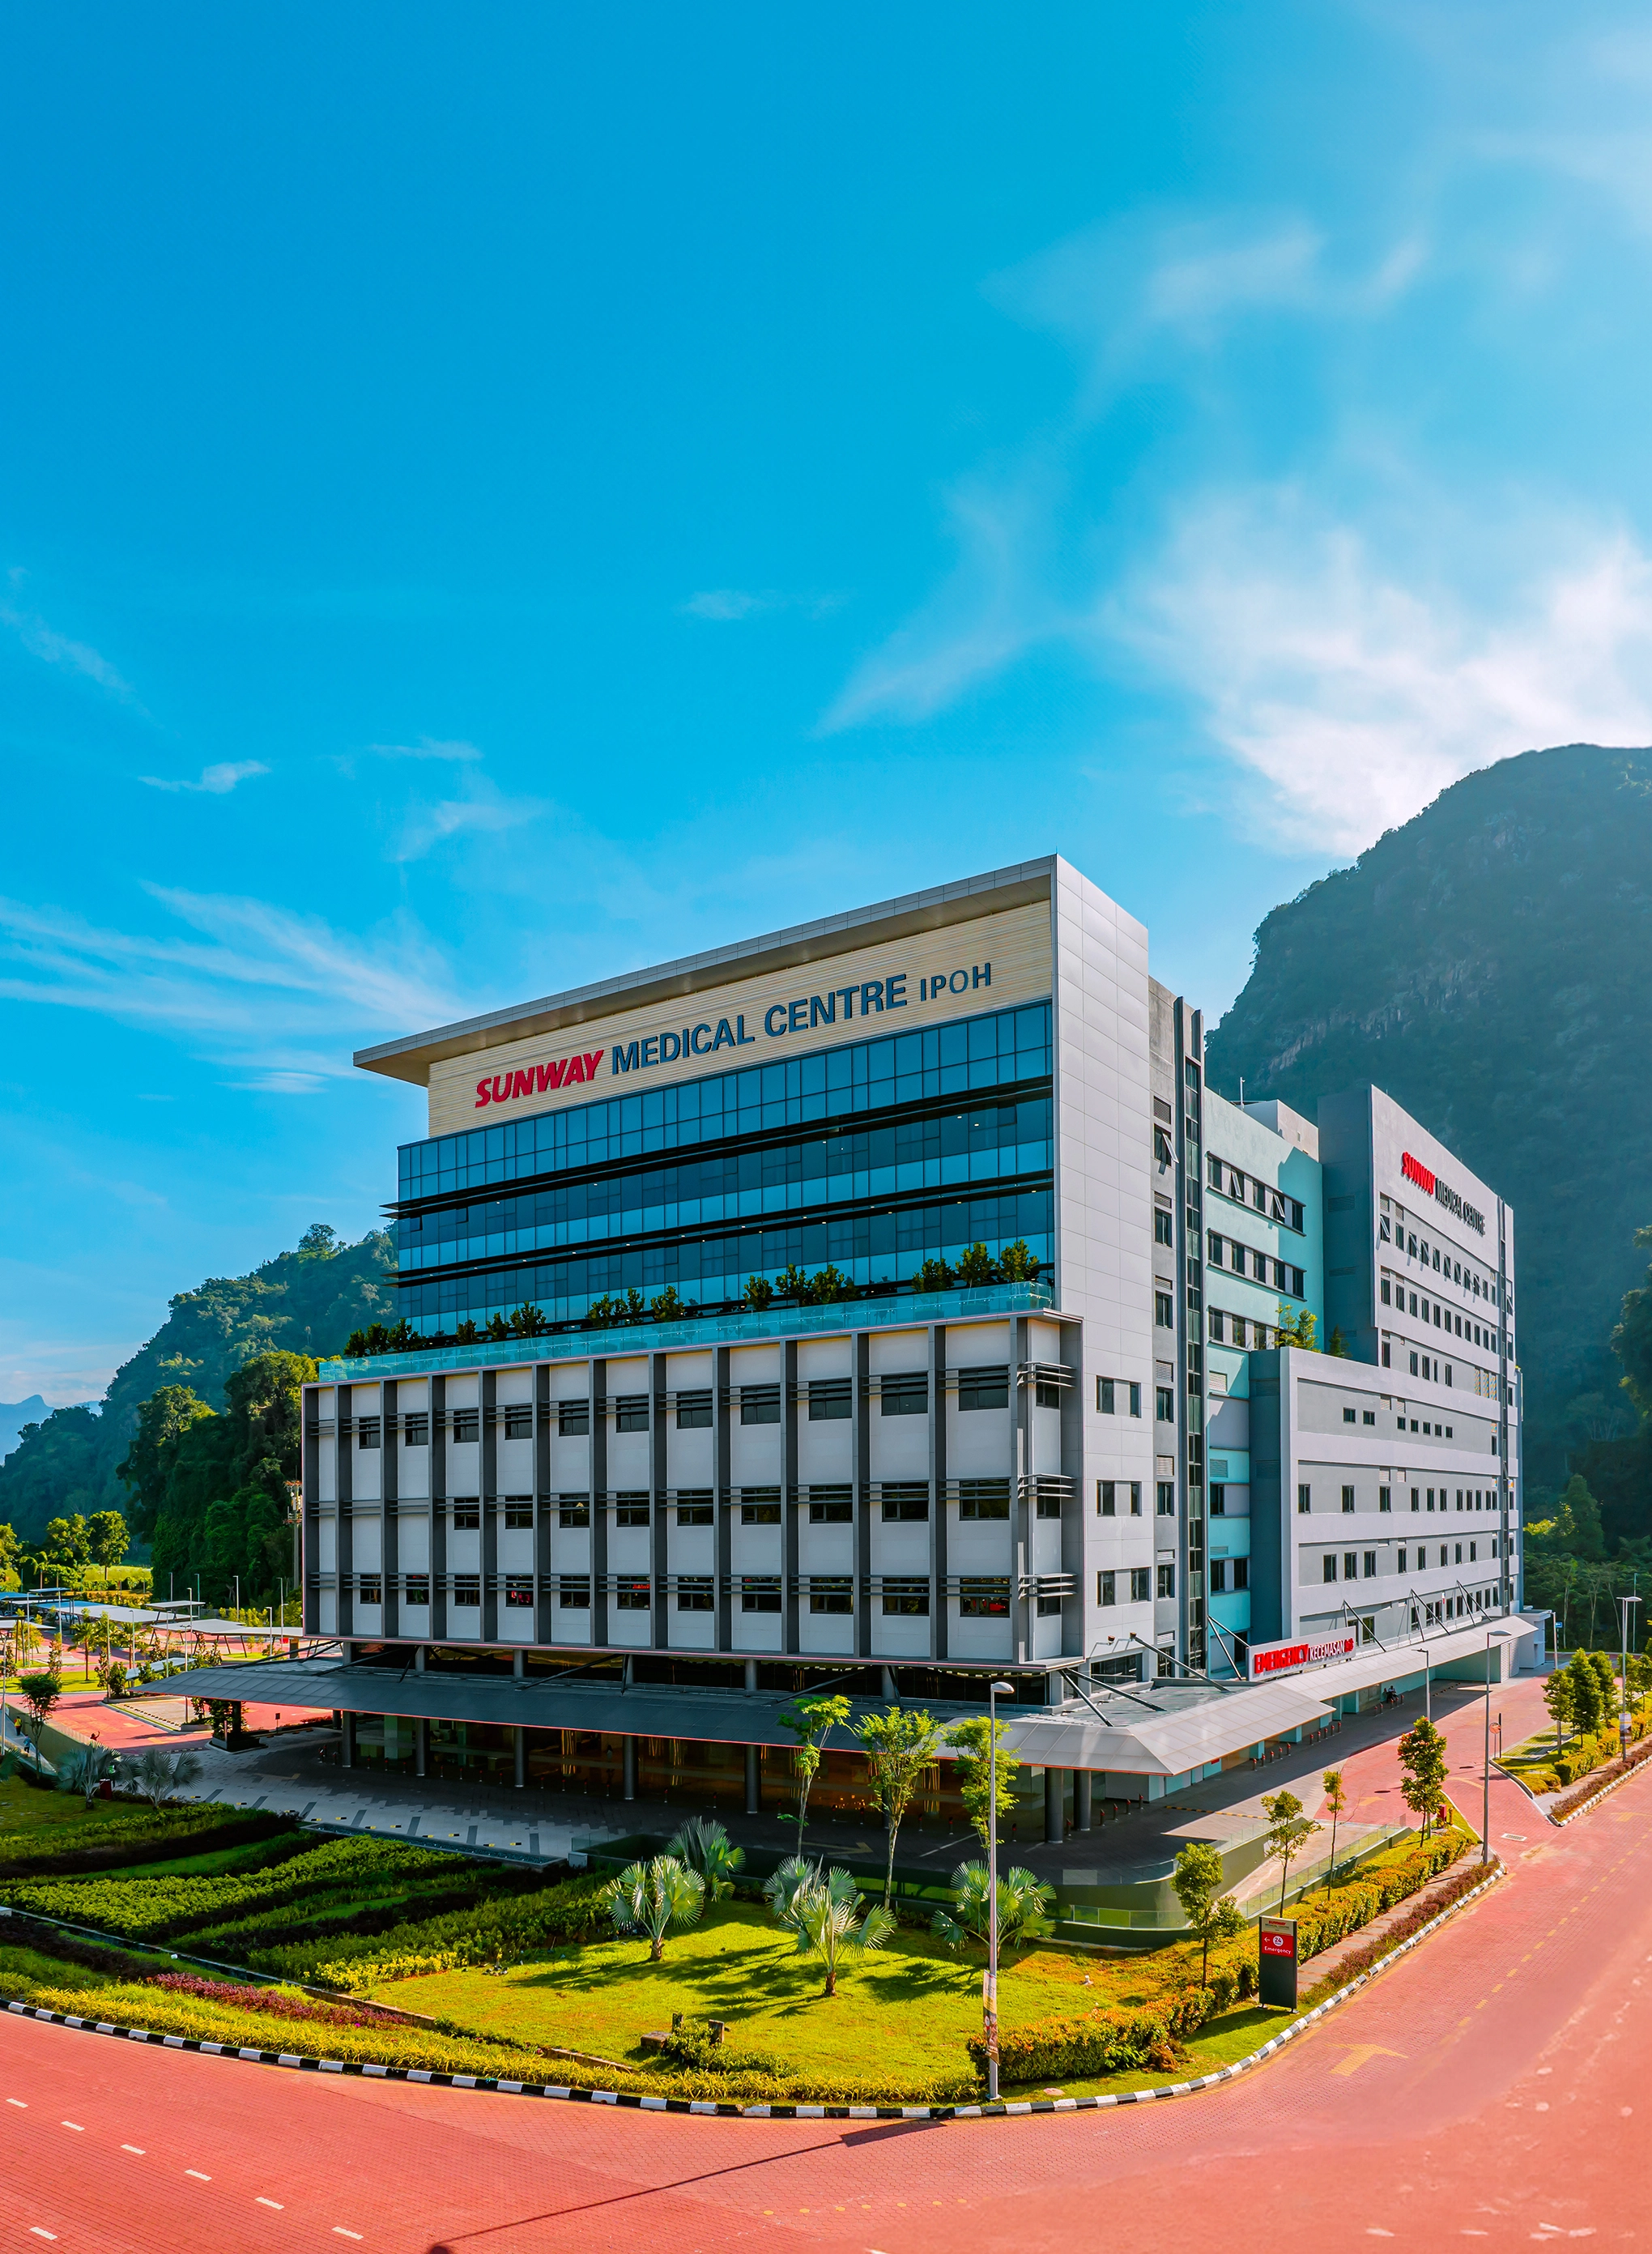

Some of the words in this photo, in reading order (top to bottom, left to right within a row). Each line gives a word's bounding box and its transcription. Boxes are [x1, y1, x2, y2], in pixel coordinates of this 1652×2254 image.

[475, 1050, 603, 1108] SUNWAY
[611, 1015, 755, 1076] MEDICAL
[764, 974, 907, 1038] CENTRE
[919, 962, 992, 1002] IPOH
[1402, 1151, 1435, 1195] SUNWAY
[1435, 1178, 1463, 1219] MEDICAL
[1463, 1201, 1485, 1236] CENTRE
[1254, 1644, 1309, 1674] EMERGENCY
[1309, 1639, 1344, 1661] KECEMASAN
[1264, 1945, 1291, 1954] Emergency
